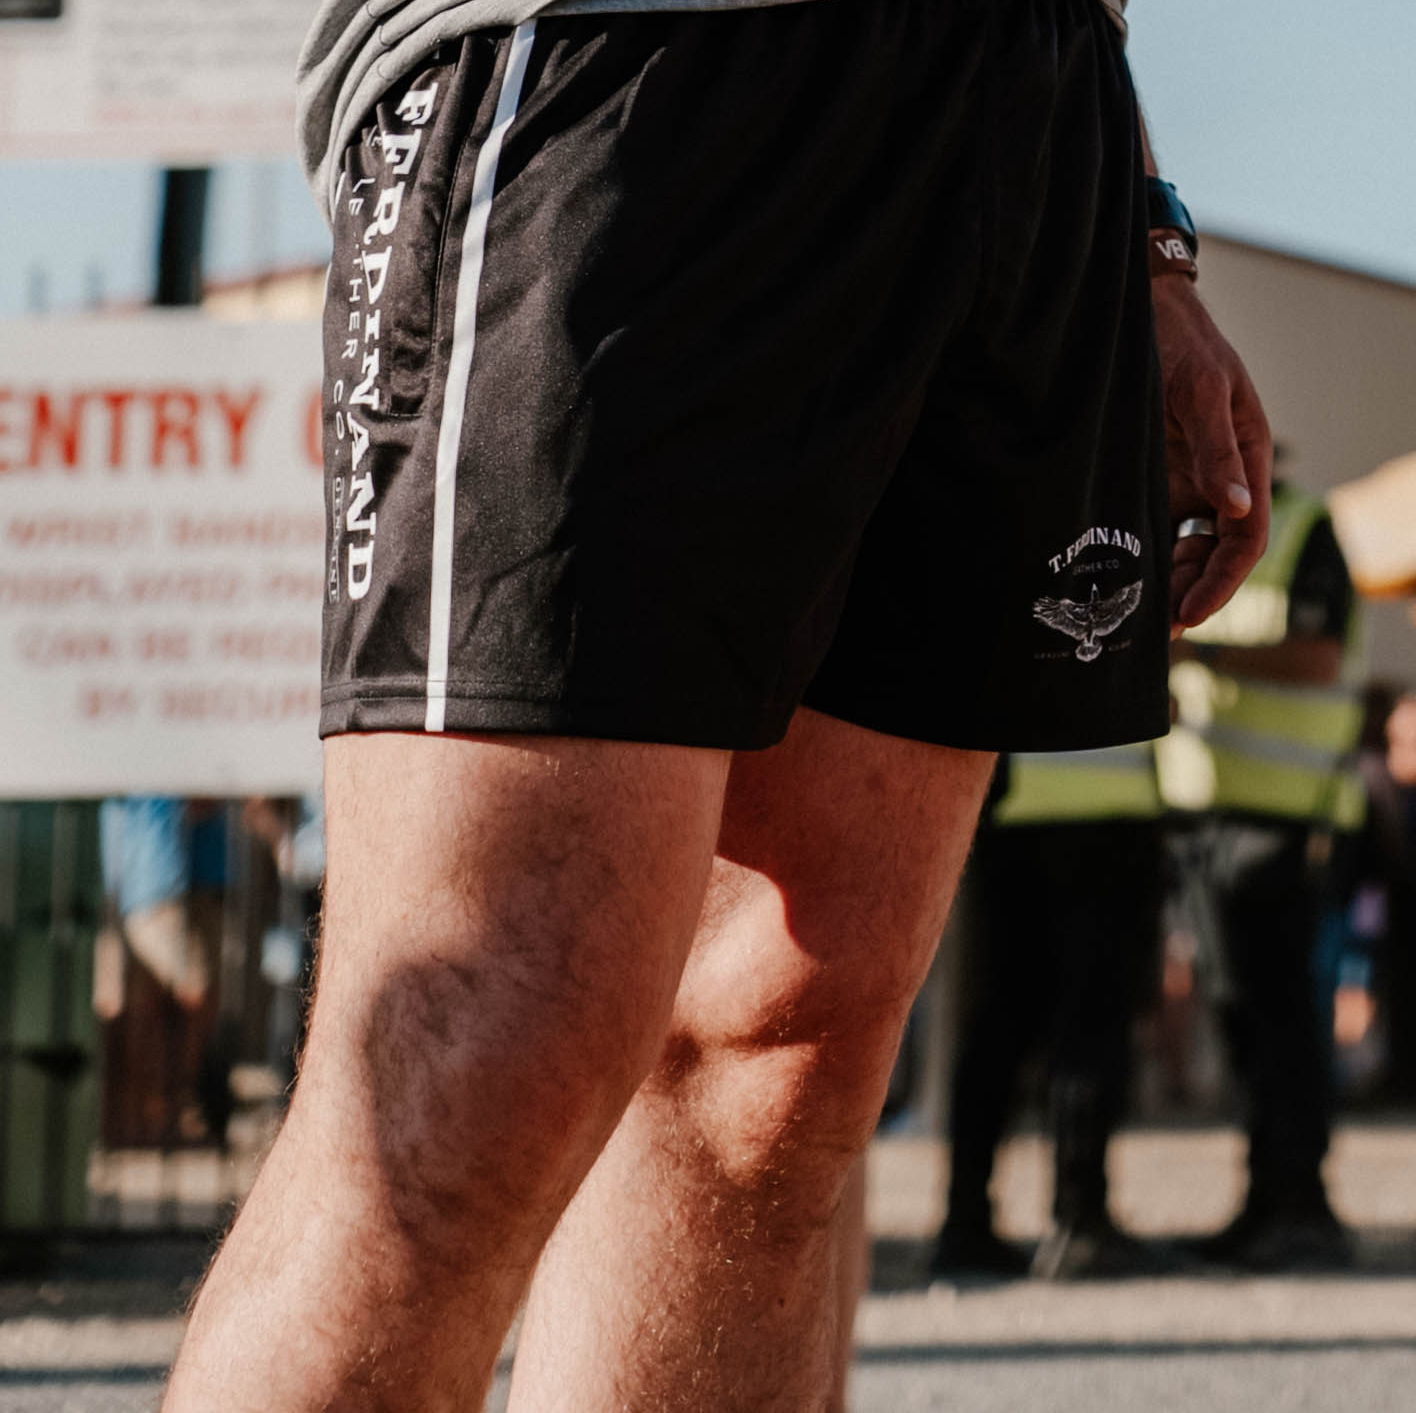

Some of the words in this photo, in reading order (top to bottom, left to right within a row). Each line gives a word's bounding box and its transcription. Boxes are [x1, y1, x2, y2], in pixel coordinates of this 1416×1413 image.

[341, 177, 376, 360] LETHER
[345, 82, 439, 600] FERDINAND
[0, 385, 262, 471] NTRY
